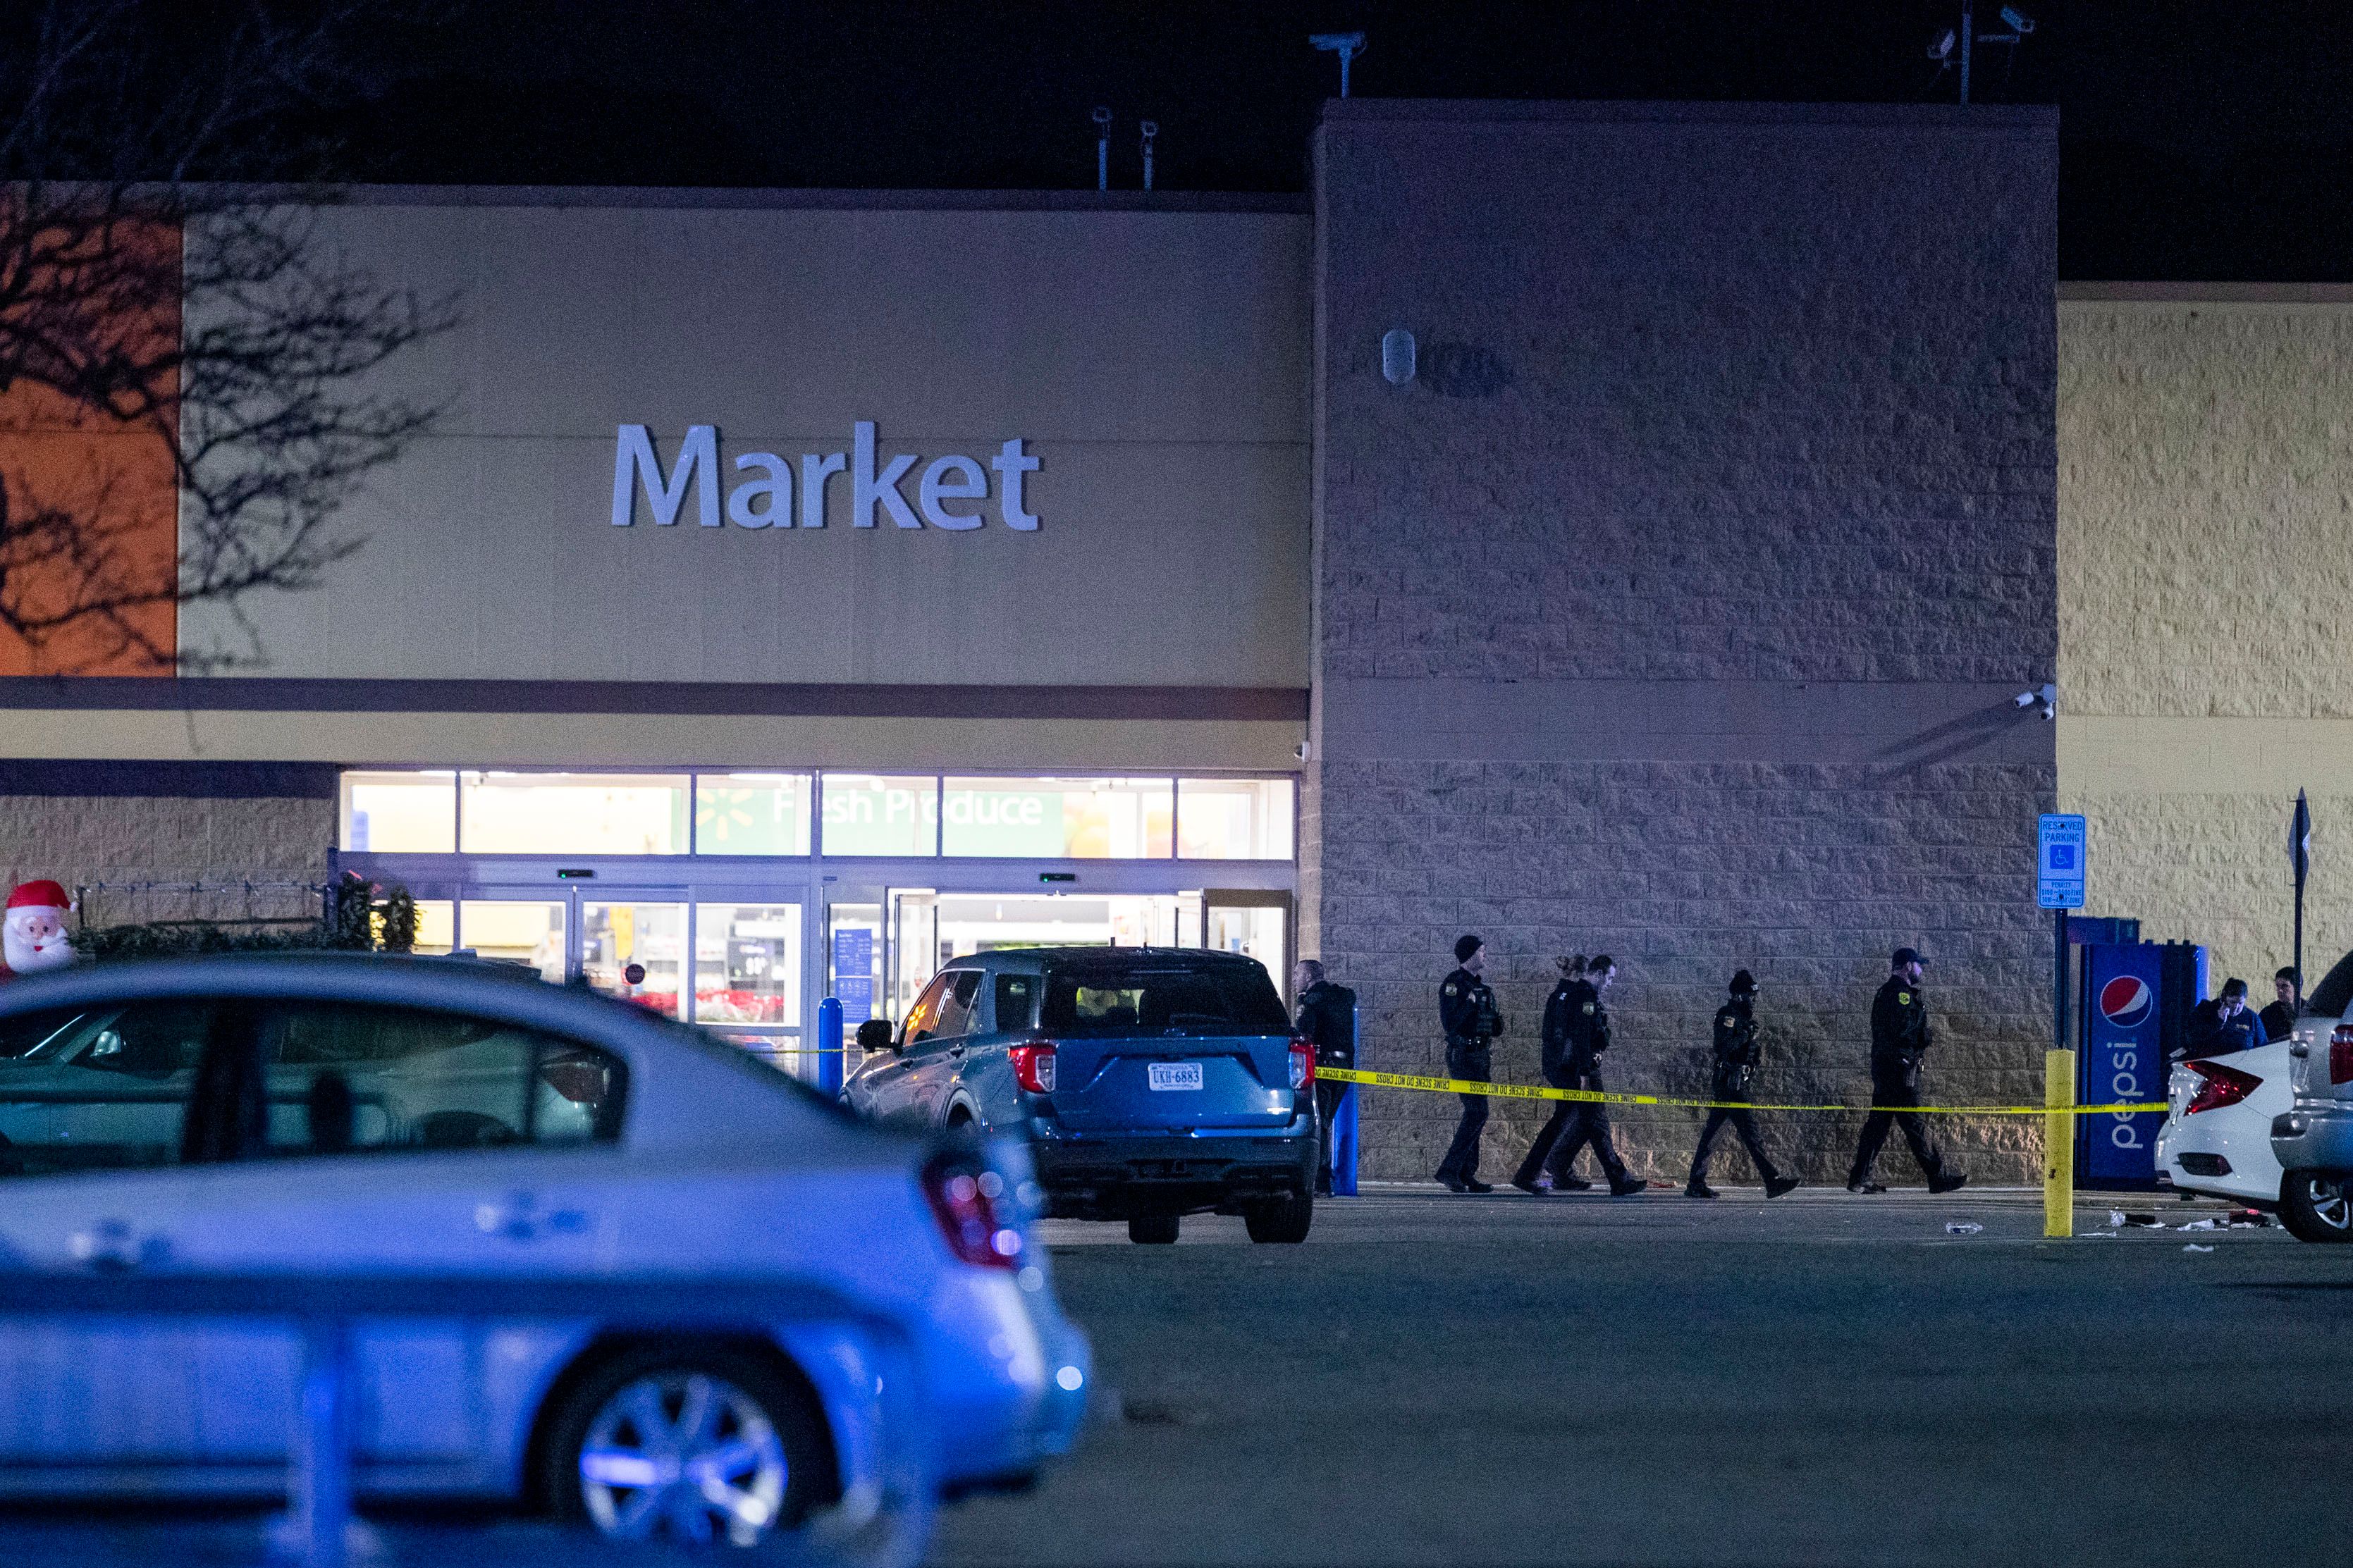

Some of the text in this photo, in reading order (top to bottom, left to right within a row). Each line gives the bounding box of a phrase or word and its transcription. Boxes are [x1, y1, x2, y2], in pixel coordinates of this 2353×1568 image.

[611, 421, 1042, 531] Market
[775, 789, 873, 824] Fsh
[2043, 821, 2083, 830] RESERVED
[2045, 833, 2079, 842] PARKING
[1153, 1070, 1199, 1083] UKH-6883
[1322, 1069, 1339, 1078] SCENE
[1341, 1071, 1356, 1080] CRIME
[1376, 1073, 1450, 1089] CRIME SCENE DO NOT CROSS
[1469, 1082, 1543, 1097] CRIME SCENE DO NOT CROSS
[1563, 1090, 1580, 1099] CROSS
[1593, 1092, 1601, 1101] DO
[1602, 1093, 1619, 1102] SCENE
[1620, 1094, 1637, 1103] CRIME
[2106, 1041, 2144, 1149] pepsi
